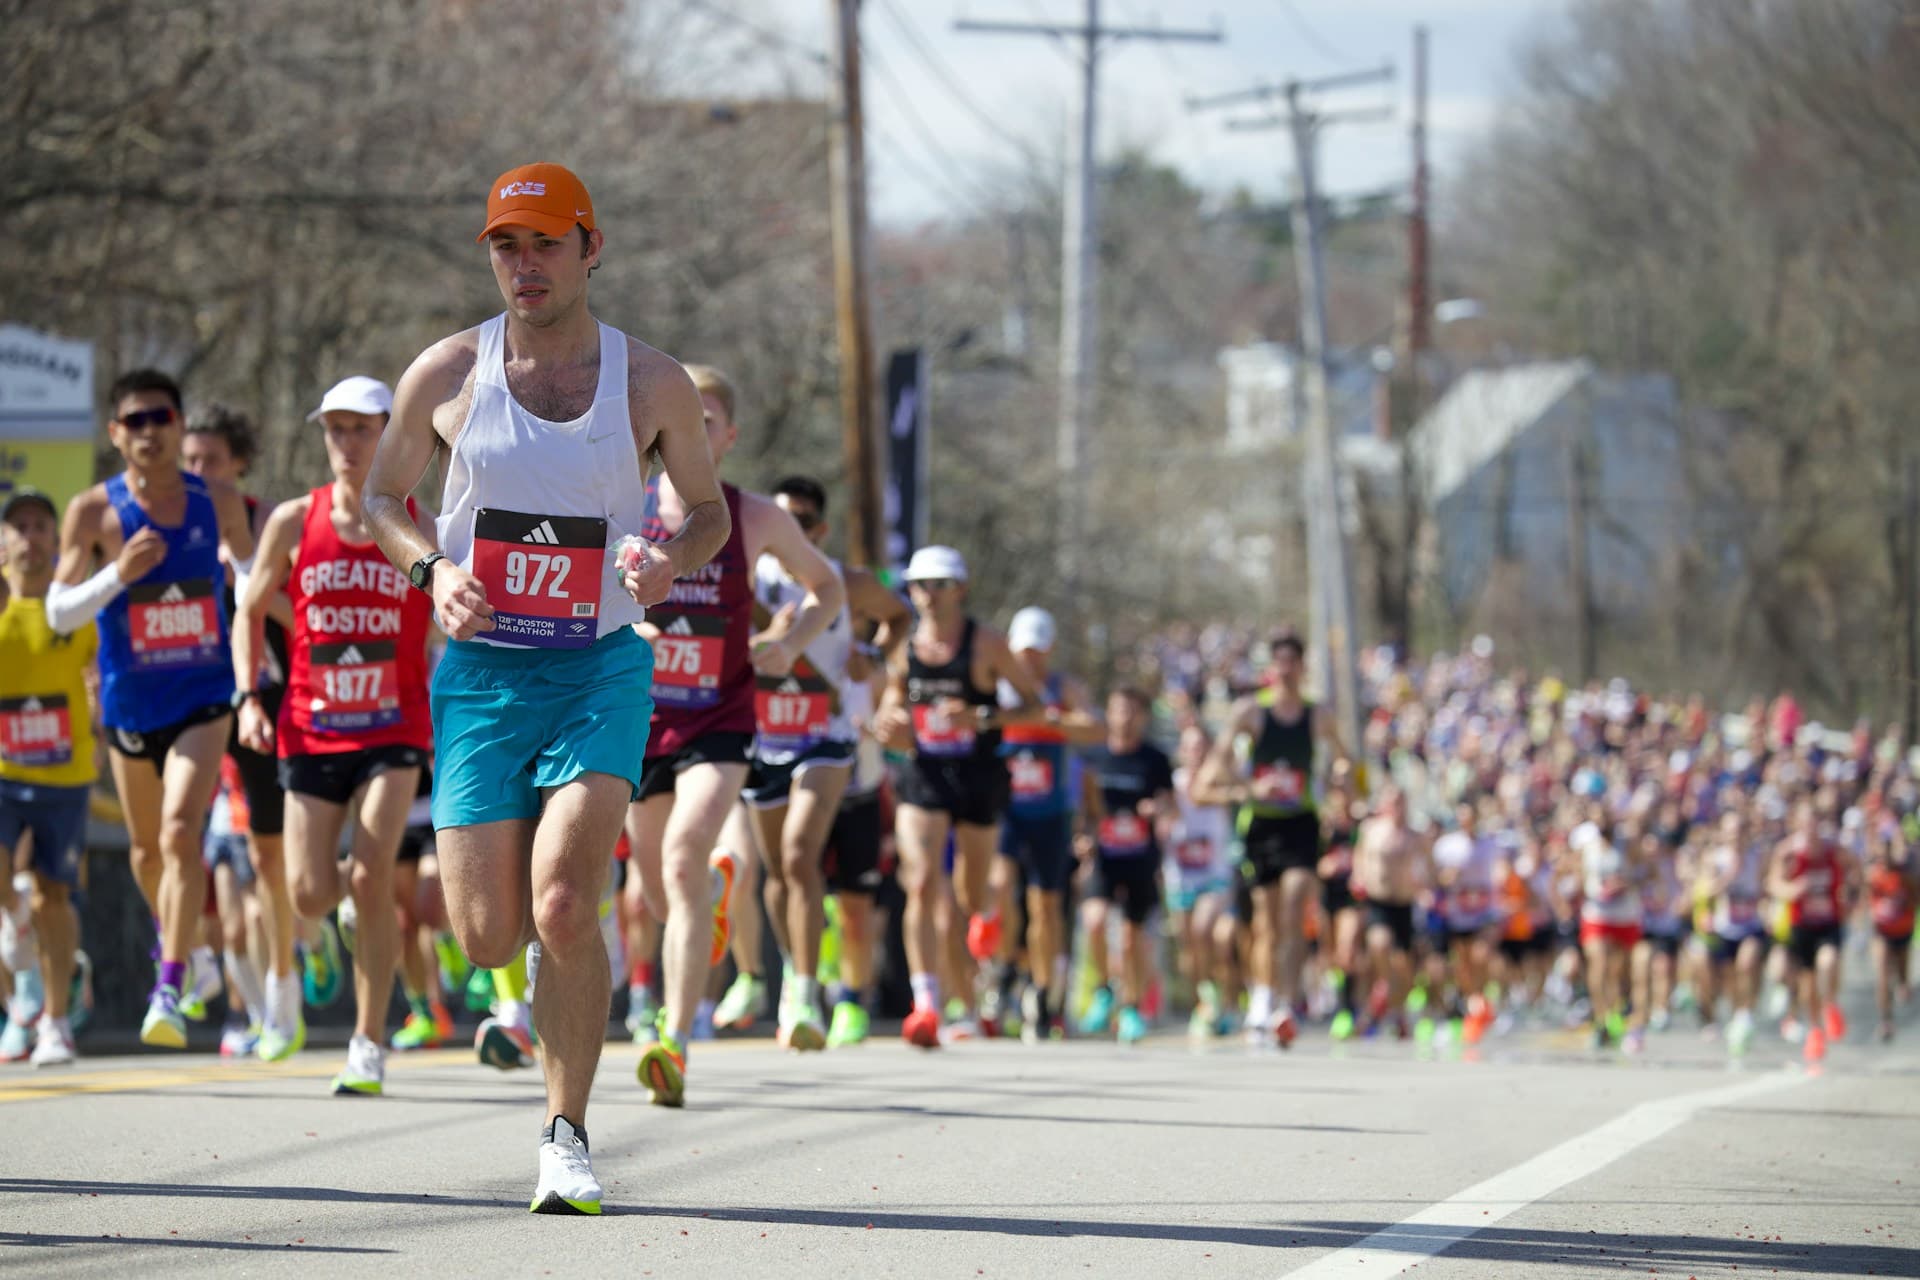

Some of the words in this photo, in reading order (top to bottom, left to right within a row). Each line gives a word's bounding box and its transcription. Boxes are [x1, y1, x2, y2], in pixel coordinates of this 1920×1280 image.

[301, 560, 408, 602] GREATER
[505, 551, 571, 598] 972
[306, 603, 401, 635] BOSTON
[517, 618, 555, 629] BOSTON
[654, 638, 702, 675] 575
[322, 667, 383, 703] 1877
